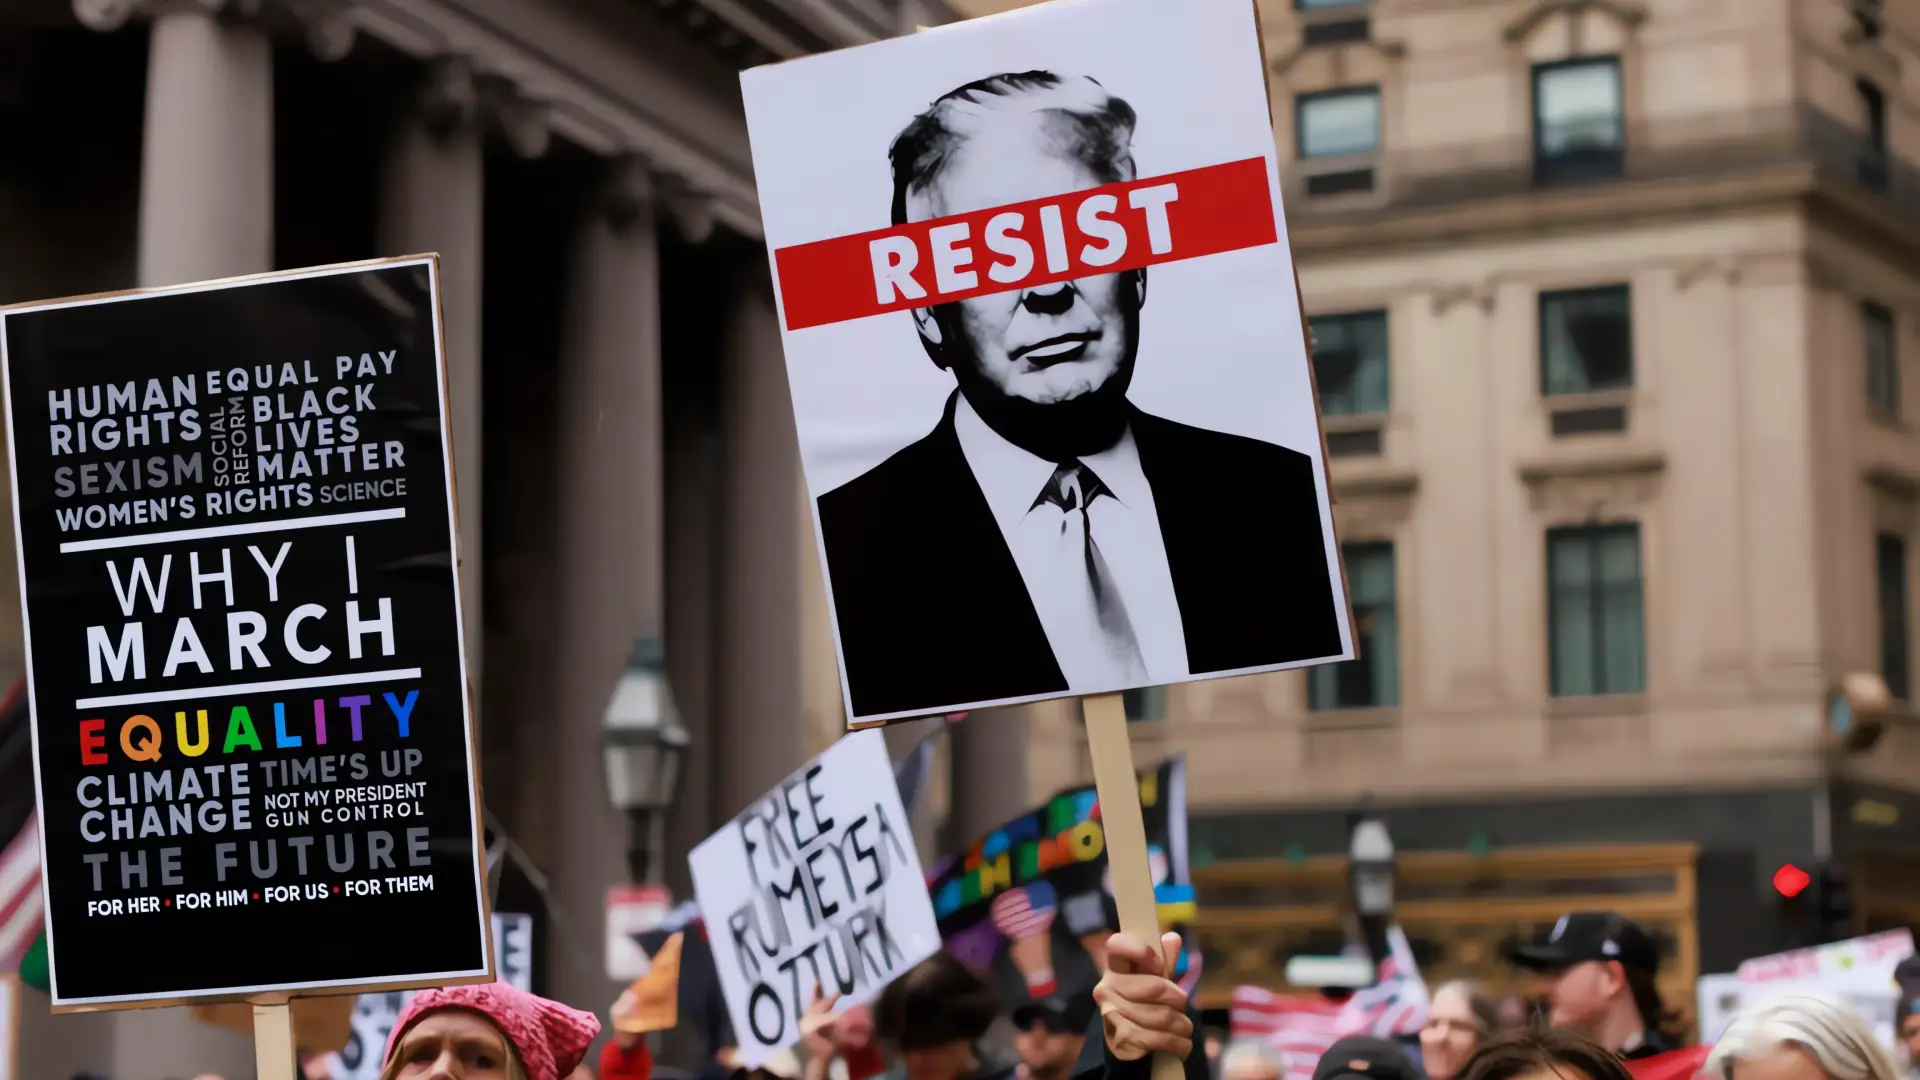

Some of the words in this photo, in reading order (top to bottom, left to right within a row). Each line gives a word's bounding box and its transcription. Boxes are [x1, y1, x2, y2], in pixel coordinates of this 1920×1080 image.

[869, 183, 1178, 304] RESIST
[206, 360, 319, 394] EQUAL
[336, 350, 396, 380] PAY
[48, 374, 197, 421] HUMAN
[253, 383, 376, 423] BLACK
[50, 409, 201, 456] RIGHTS
[209, 406, 229, 487] SOCIAL
[229, 396, 250, 485] REFORM
[255, 415, 359, 452] LIVES
[54, 452, 203, 498] SEXISM
[257, 440, 405, 482] MATTER
[55, 495, 196, 532] WOMEN'S
[206, 483, 313, 516] RIGHTS
[320, 478, 407, 504] SCIENCE
[106, 542, 292, 616] WHY
[345, 536, 358, 594] I
[87, 597, 396, 684] MARCH
[80, 690, 420, 765] EQUALITY
[77, 763, 250, 808] CLIMATE
[260, 753, 369, 787] TIME'S
[381, 749, 422, 777] UP
[264, 793, 300, 810] NOT
[305, 789, 329, 806] MY
[335, 782, 426, 804] PRESIDENT
[266, 811, 309, 828] GUN
[321, 801, 424, 823] CONTROL
[80, 798, 251, 842] CHANGE
[740, 764, 835, 889] FREE
[83, 847, 184, 891] THE
[215, 827, 431, 882] FUTURE
[88, 900, 123, 917] FOR
[128, 897, 160, 914] HER
[176, 893, 211, 910] FOR
[216, 890, 248, 907] HIM
[264, 886, 300, 903] FOR
[305, 883, 328, 900] US
[345, 880, 381, 896] FOR
[385, 875, 434, 893] THEM
[728, 803, 907, 980] RUMEYSA
